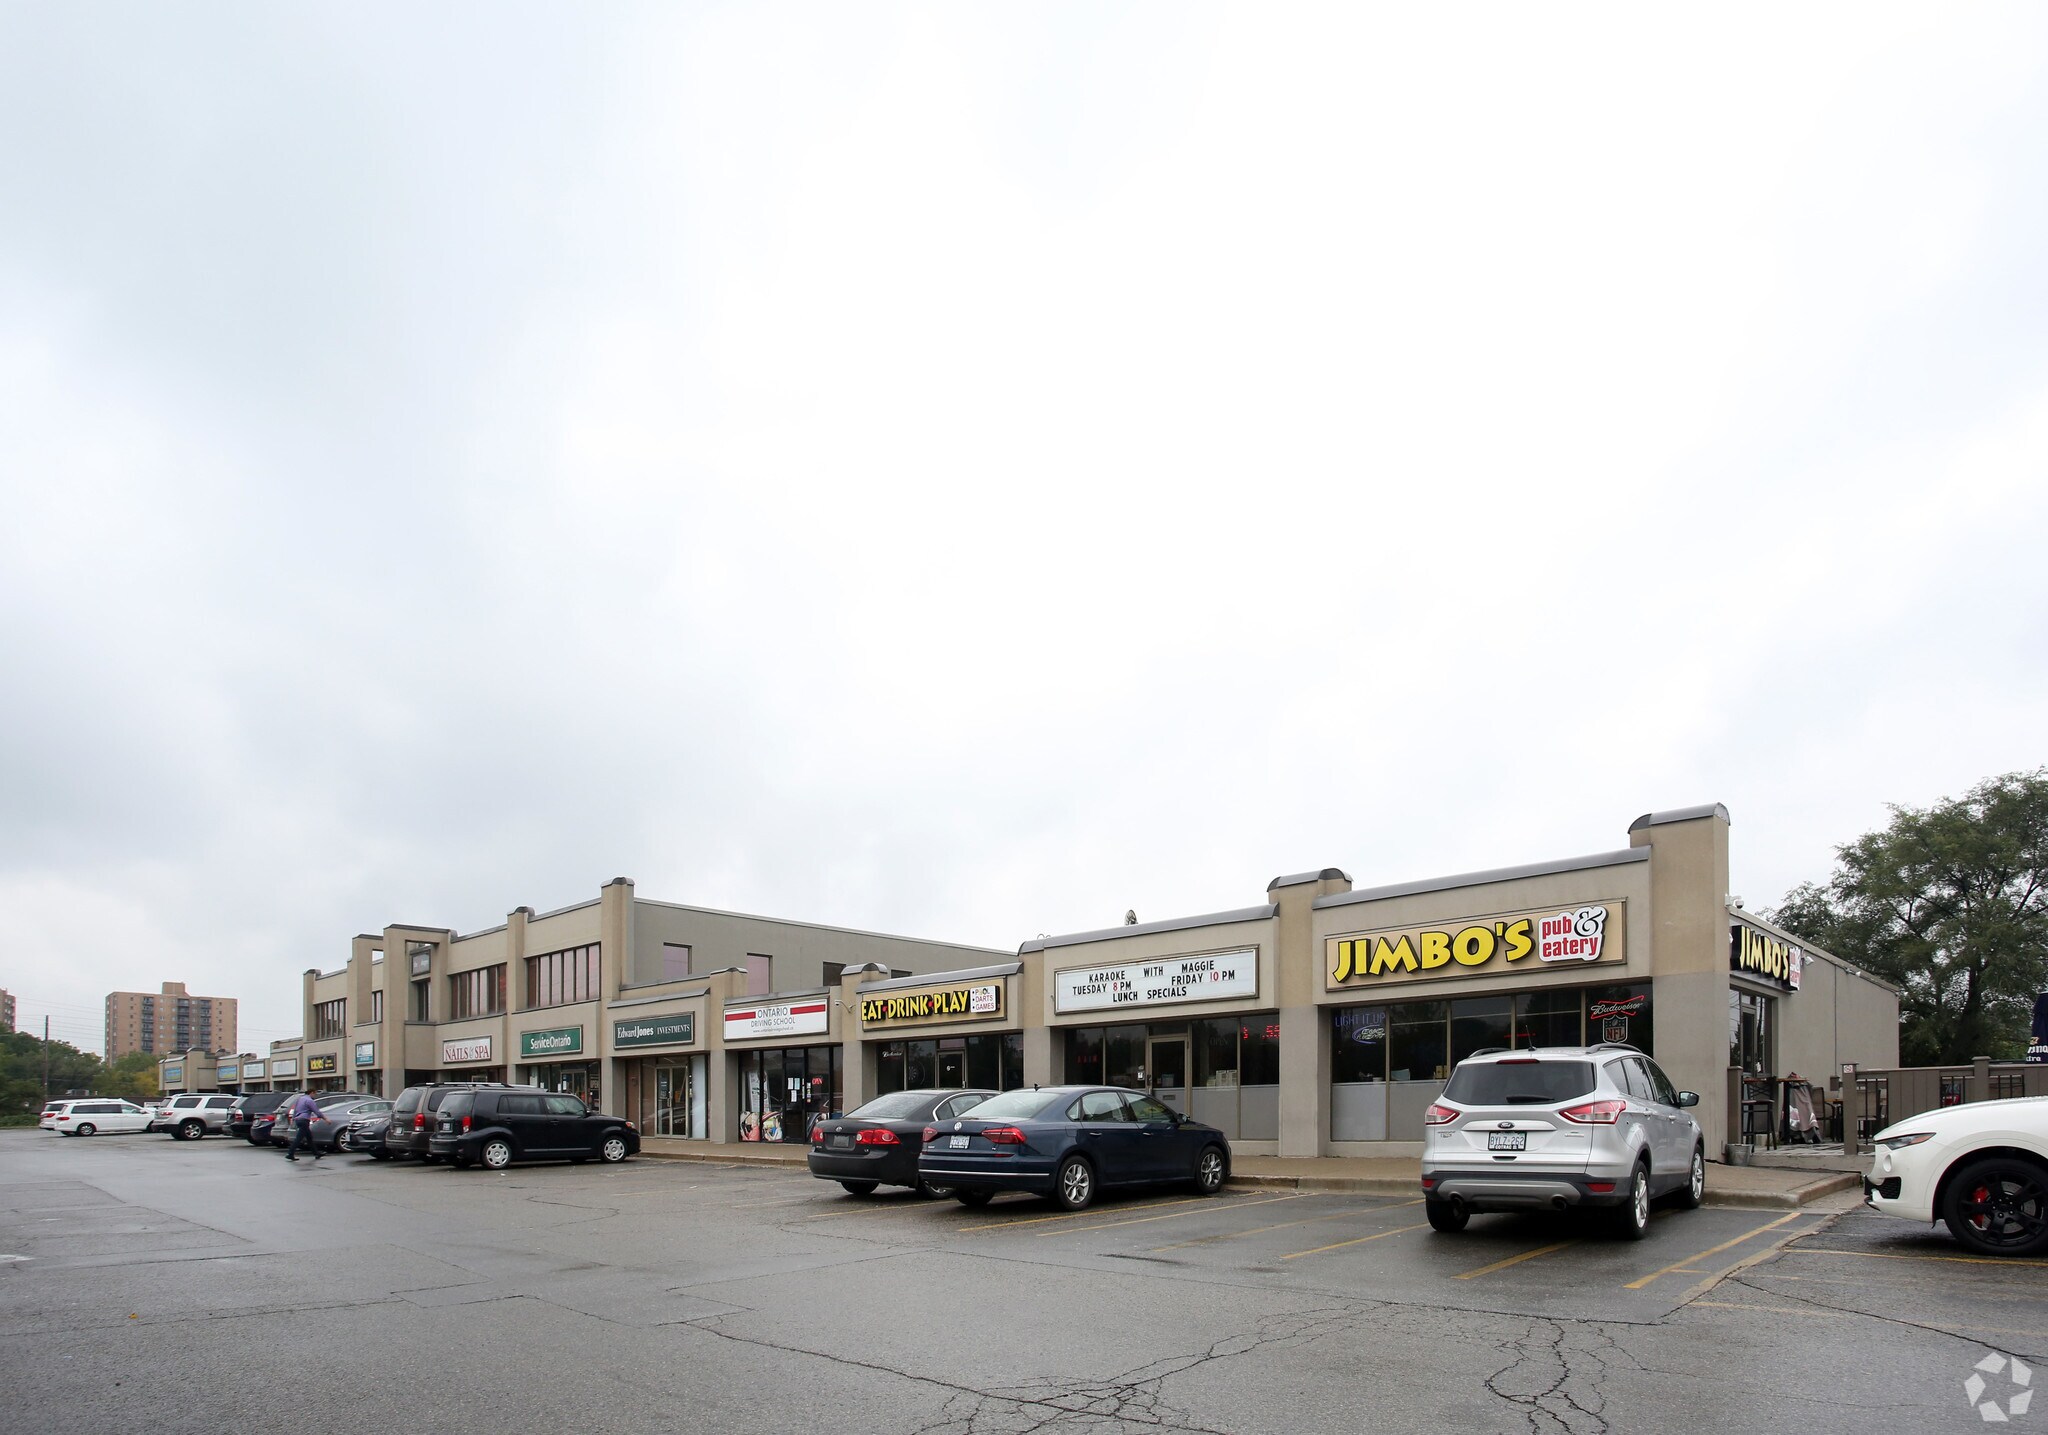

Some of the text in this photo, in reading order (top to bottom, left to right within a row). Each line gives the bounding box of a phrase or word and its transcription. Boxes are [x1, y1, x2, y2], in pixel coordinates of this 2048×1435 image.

[1542, 907, 1604, 937] pub &
[1332, 918, 1533, 984] JIMBO'S
[1542, 936, 1600, 959] eatery
[1740, 925, 1789, 980] JIMBO'S
[1089, 960, 1215, 983] KARAOKE WITH MAGGIE
[1171, 970, 1235, 986] FRIDAY 10 PM
[1072, 981, 1132, 996] TUESDAY 8 PM
[1113, 986, 1187, 1003] LUNCH SPECIALS
[861, 990, 969, 1021] EAT DRINK PLAY
[975, 994, 993, 1003] DARTS
[975, 1002, 995, 1010] GAMES
[757, 1007, 788, 1018] ONTARIO
[1335, 1012, 1386, 1027] LIGHT IT UP
[657, 1024, 691, 1035] INVESTMENTS
[751, 1017, 796, 1028] DRIVING SCHOOL
[1606, 1027, 1625, 1040] NFL
[530, 1034, 572, 1050] ServiceOntario
[445, 1046, 469, 1060] NAILS
[474, 1044, 490, 1059] SPA
